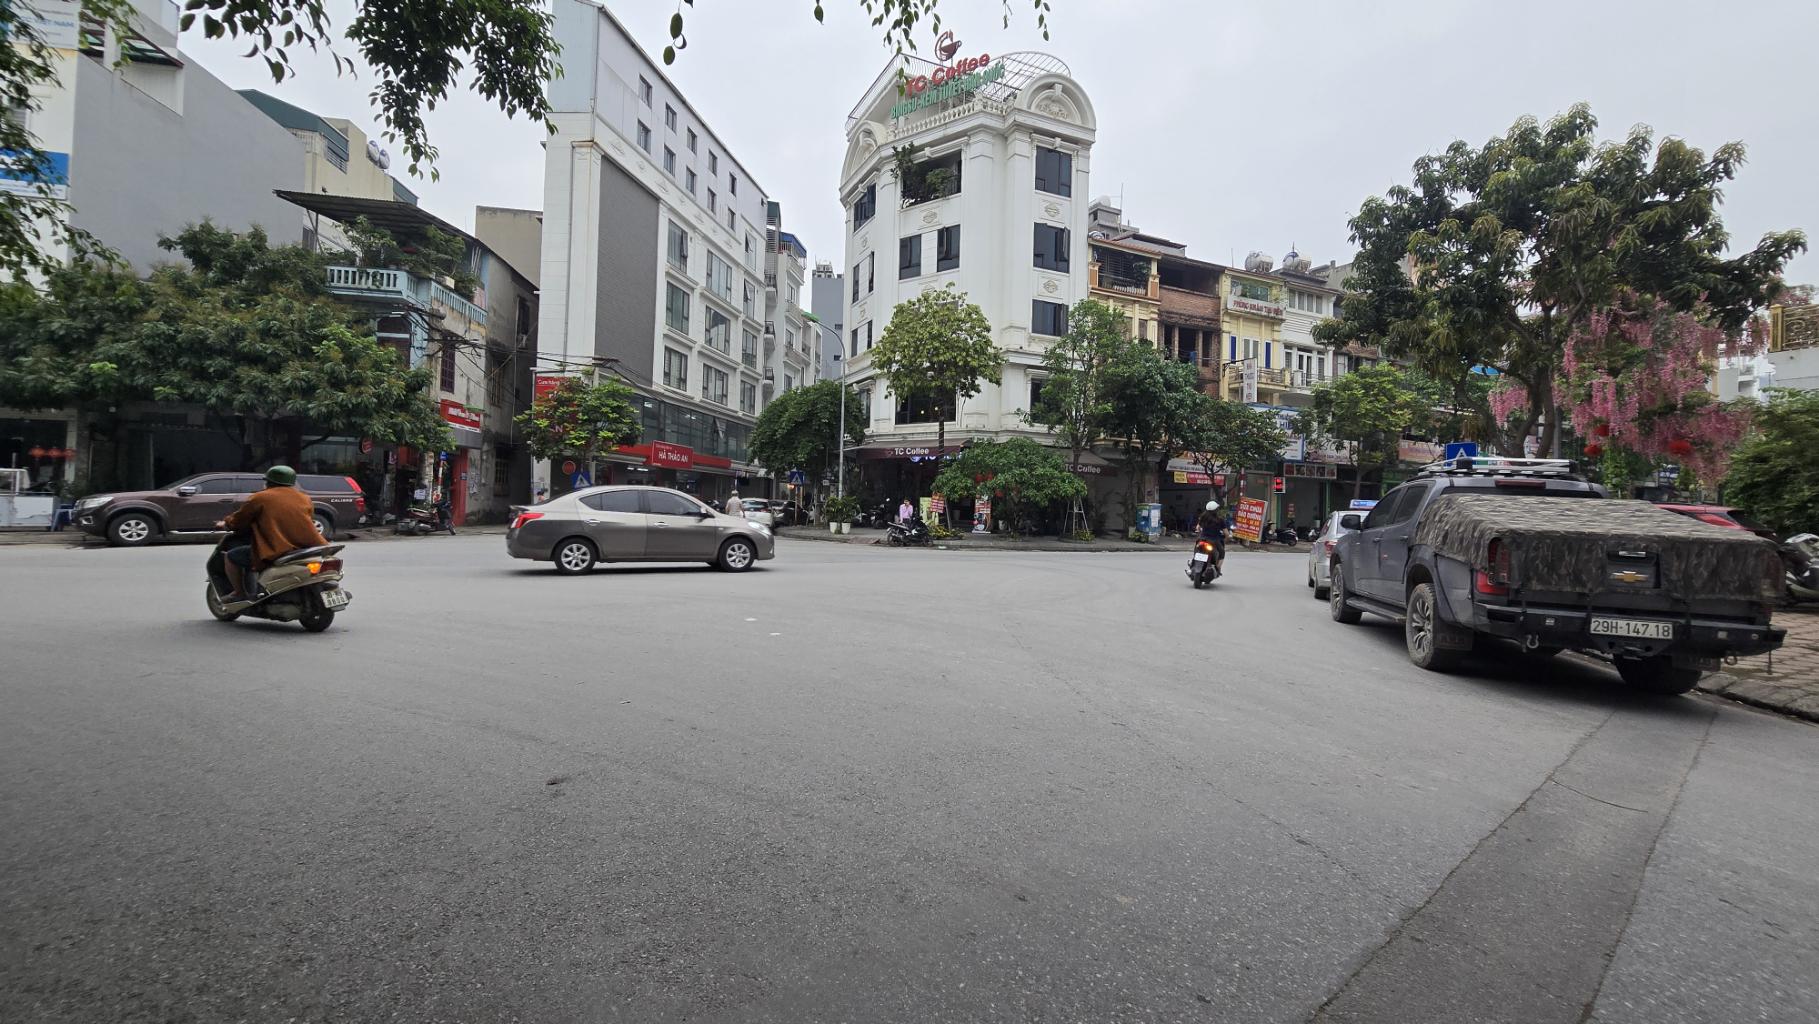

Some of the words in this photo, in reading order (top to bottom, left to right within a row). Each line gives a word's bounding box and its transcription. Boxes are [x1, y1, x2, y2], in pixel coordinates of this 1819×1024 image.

[906, 75, 927, 96] TC
[931, 53, 990, 85] Coffee
[894, 447, 904, 455] TC
[906, 447, 929, 455] Coffee
[1064, 463, 1074, 472] TC
[1077, 464, 1101, 474] Coffee
[1592, 619, 1670, 637] 29H-147.18
